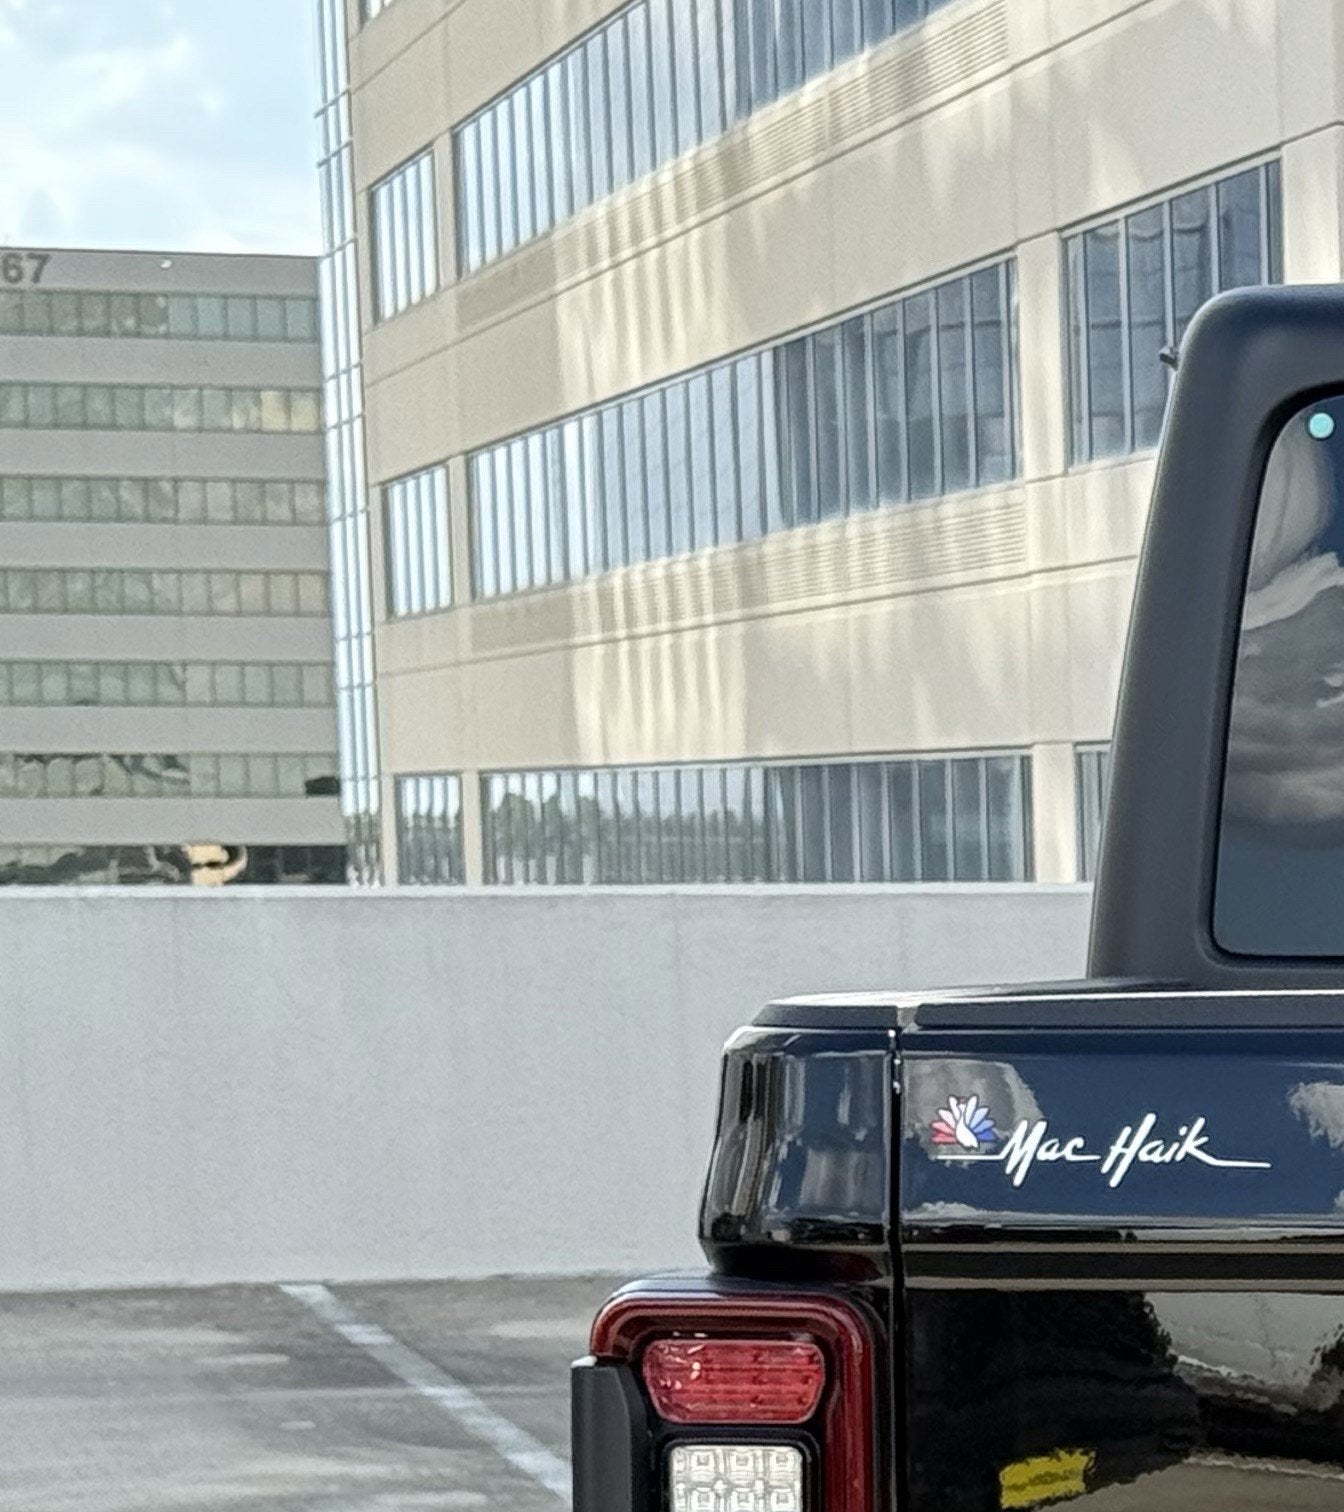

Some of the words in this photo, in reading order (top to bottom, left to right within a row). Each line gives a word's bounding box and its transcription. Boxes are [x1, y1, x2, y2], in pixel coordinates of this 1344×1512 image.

[1, 252, 51, 285] 67
[936, 1118, 1101, 1188] Mac
[1100, 1111, 1272, 1188] Haik
